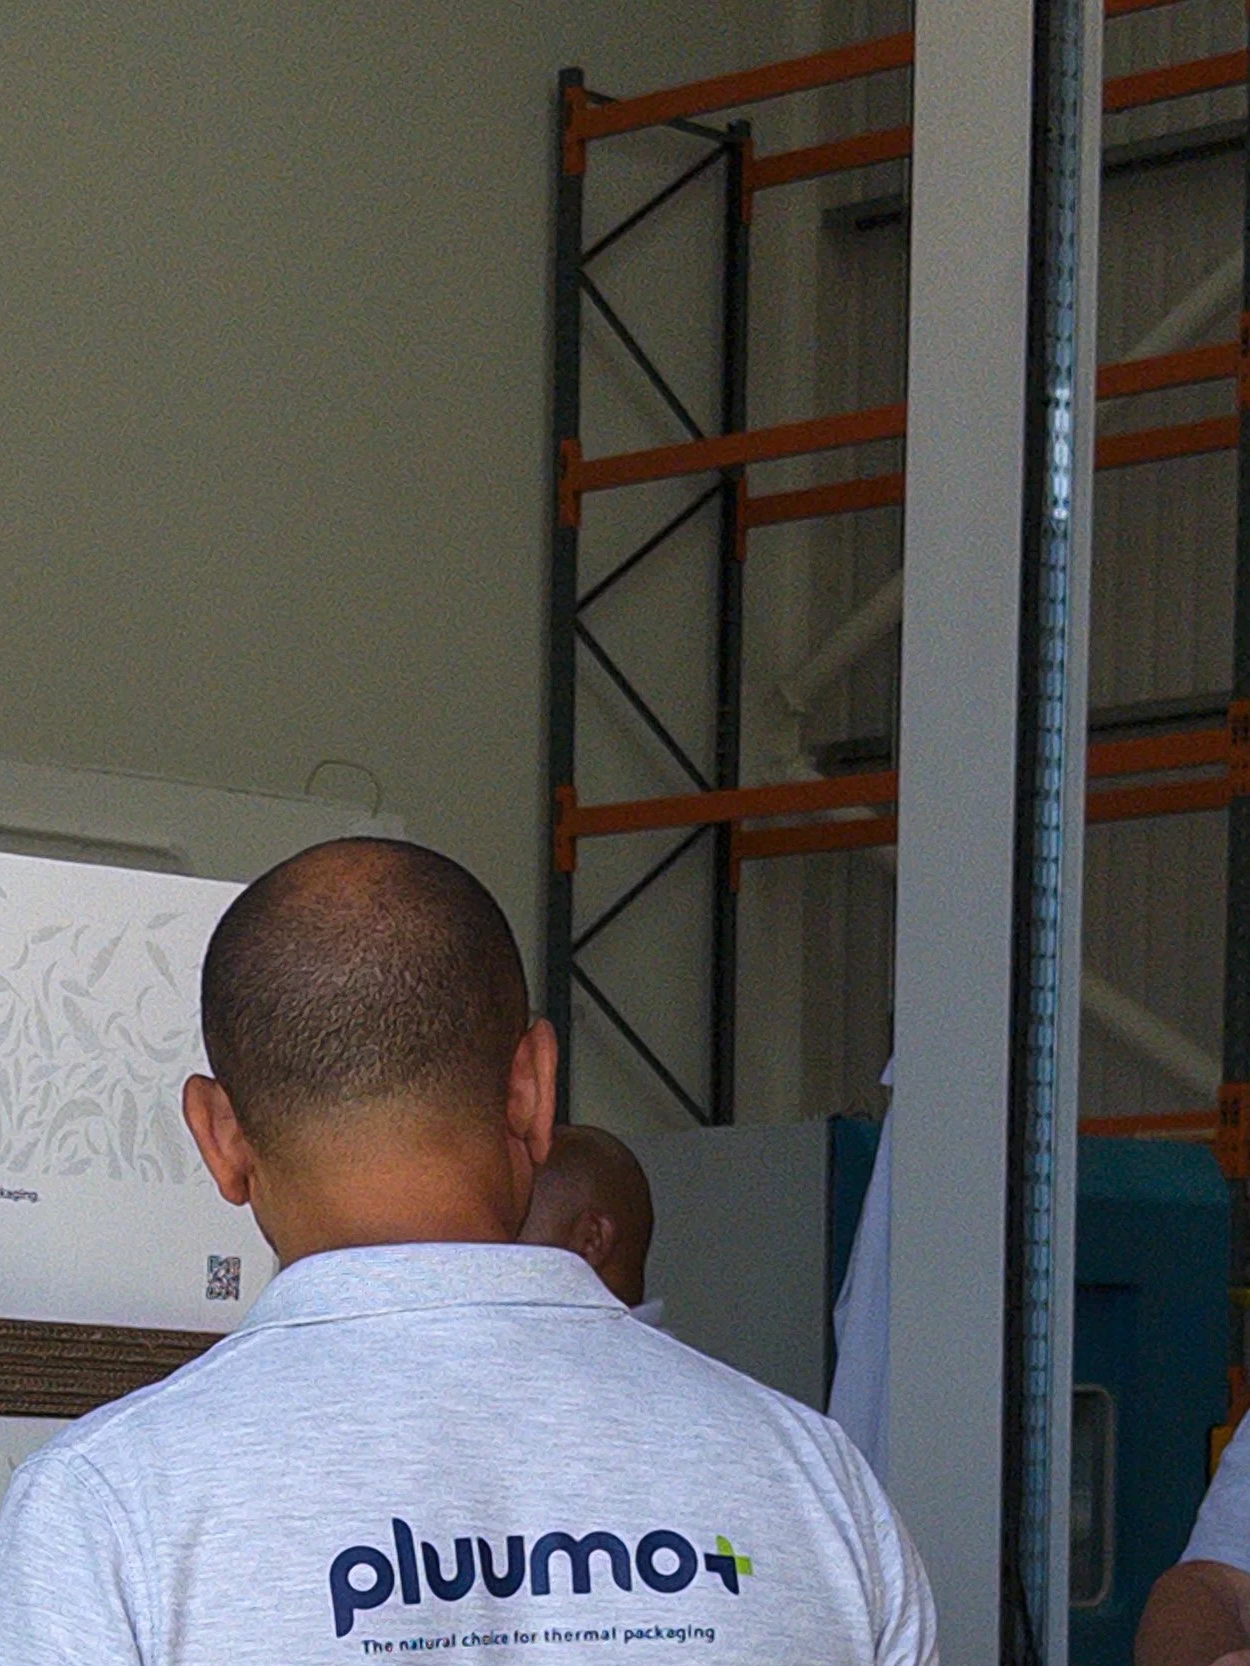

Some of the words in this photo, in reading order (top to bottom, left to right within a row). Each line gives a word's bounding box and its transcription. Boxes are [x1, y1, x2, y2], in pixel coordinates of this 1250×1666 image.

[362, 1638, 393, 1655] The
[399, 1633, 456, 1651] natural
[461, 1631, 509, 1648] choice
[513, 1629, 539, 1645] for
[544, 1626, 617, 1643] thermal
[623, 1623, 716, 1645] packaging
